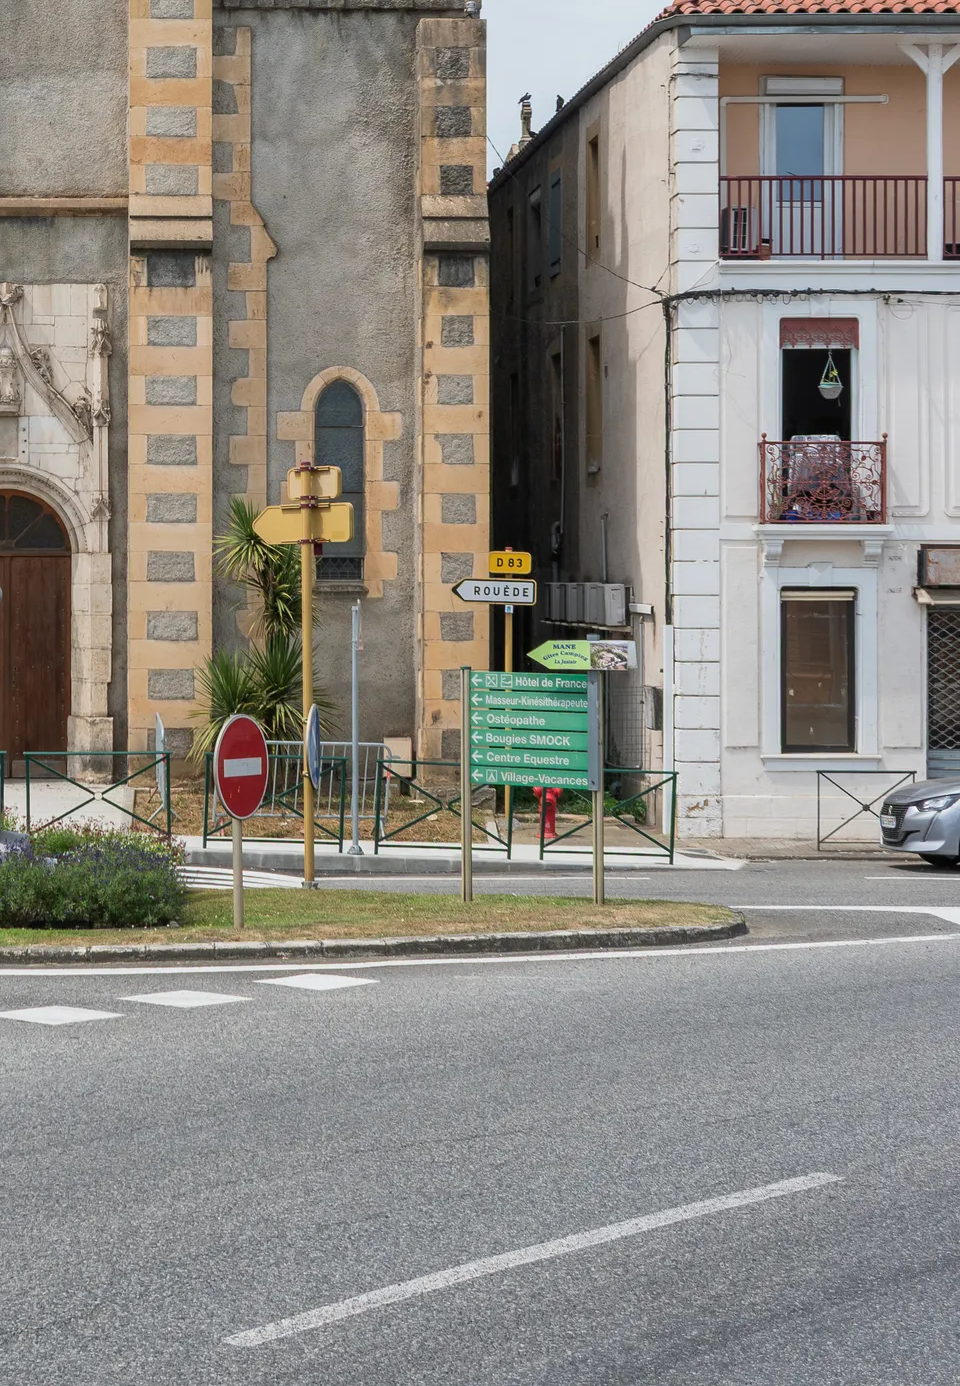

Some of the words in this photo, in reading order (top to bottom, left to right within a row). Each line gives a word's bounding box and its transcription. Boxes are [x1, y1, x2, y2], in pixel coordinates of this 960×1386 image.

[497, 558, 504, 567] D
[507, 558, 523, 568] 83
[473, 585, 529, 597] ROUÈDE
[560, 650, 589, 662] Camping
[515, 676, 539, 687] Hôtel
[541, 678, 553, 688] de
[555, 678, 588, 689] France
[485, 694, 588, 709] Masseur-Kinésithérapeute
[486, 713, 545, 726] Ostéopathe
[485, 732, 527, 746] Bougies
[529, 734, 570, 746] SMOCK
[486, 751, 521, 763] Centre
[523, 753, 570, 766] Equestre
[500, 771, 588, 786] Village-Vacances
